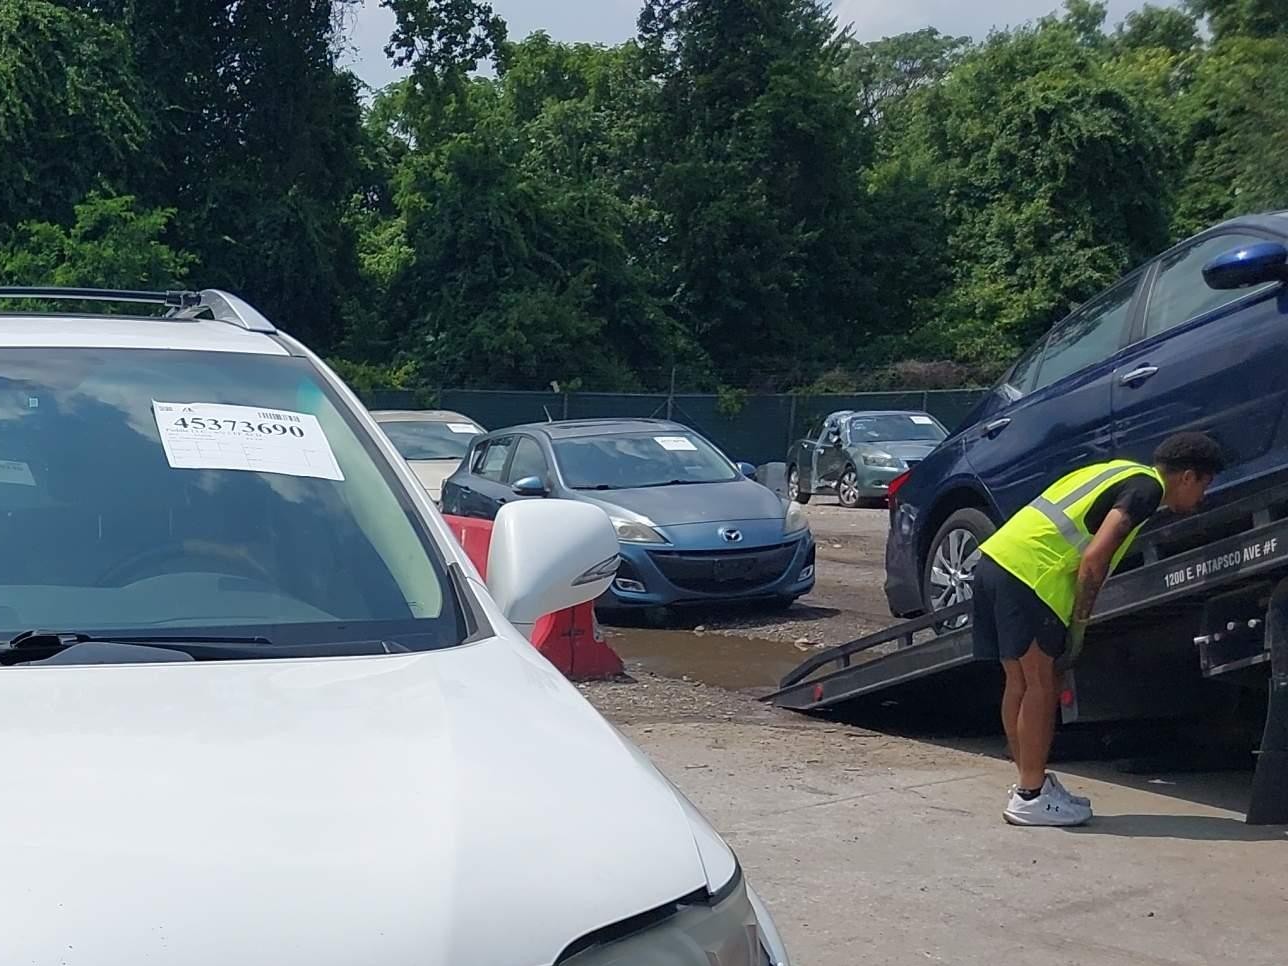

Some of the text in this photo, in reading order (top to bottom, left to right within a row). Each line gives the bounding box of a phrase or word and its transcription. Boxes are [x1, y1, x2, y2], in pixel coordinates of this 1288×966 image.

[174, 417, 305, 438] 45373690
[1164, 569, 1185, 587] 1200
[1196, 551, 1241, 577] PATAPSCO
[1243, 544, 1261, 562] AVE
[1263, 538, 1278, 555] #F
